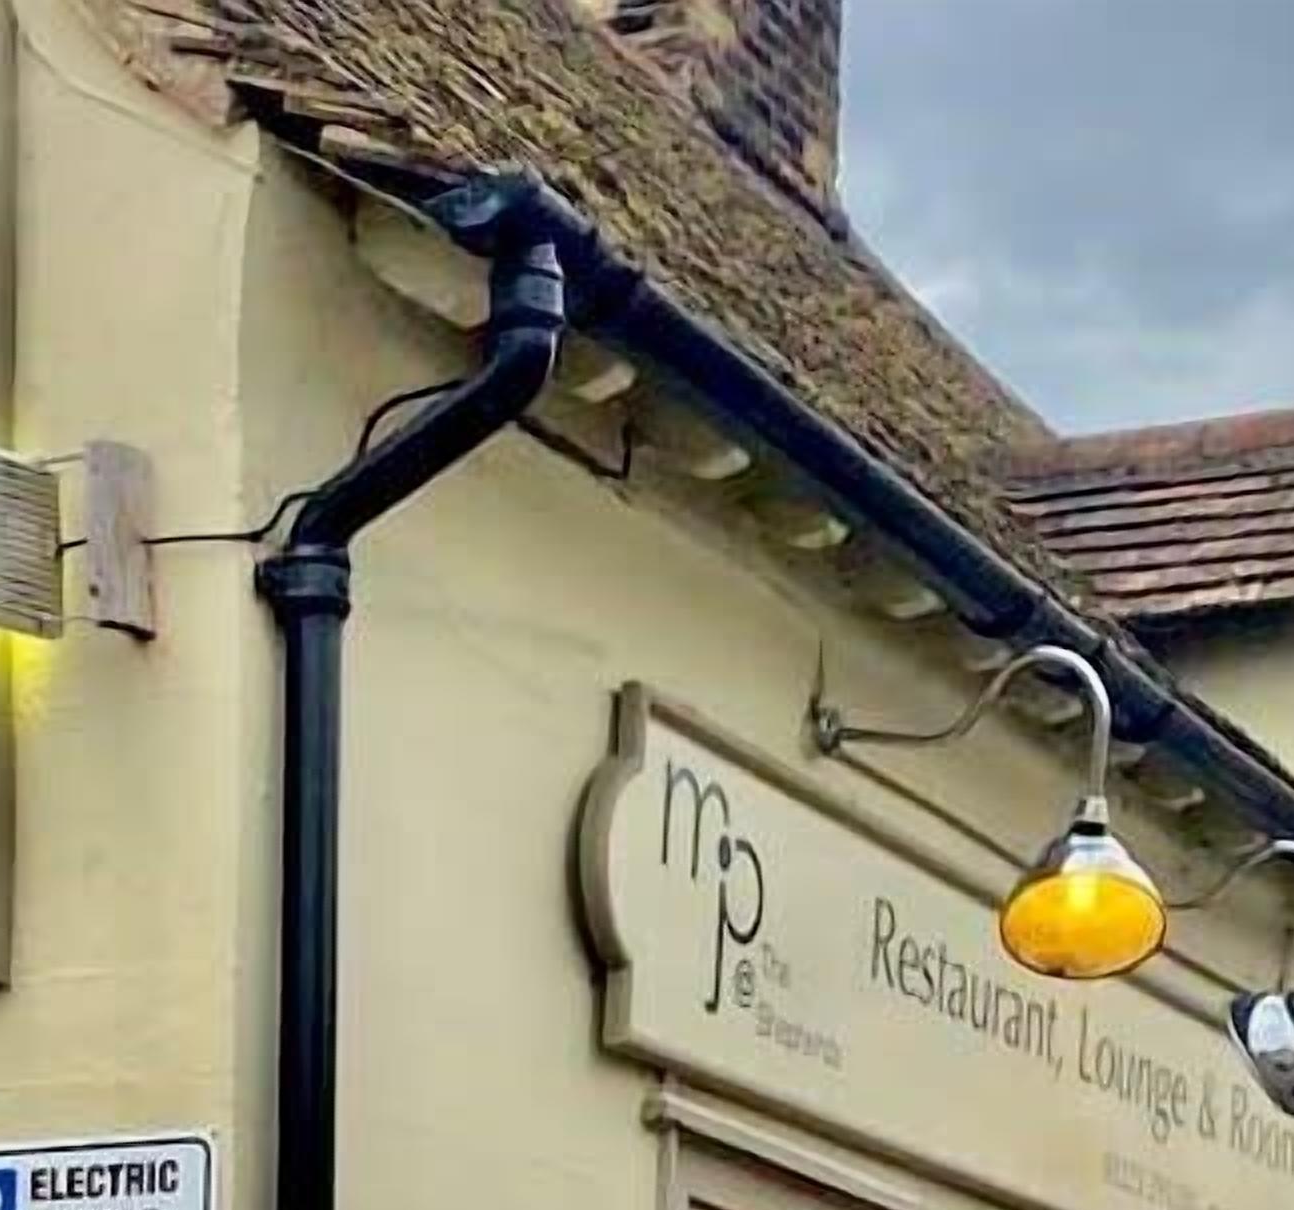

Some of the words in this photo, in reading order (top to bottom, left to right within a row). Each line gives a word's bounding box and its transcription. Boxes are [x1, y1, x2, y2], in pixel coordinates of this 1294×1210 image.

[871, 896, 1064, 1082] Restaurant,
[1079, 1005, 1188, 1145] Lounge
[1197, 1067, 1217, 1139] &
[29, 1159, 181, 1201] ELECTRIC
